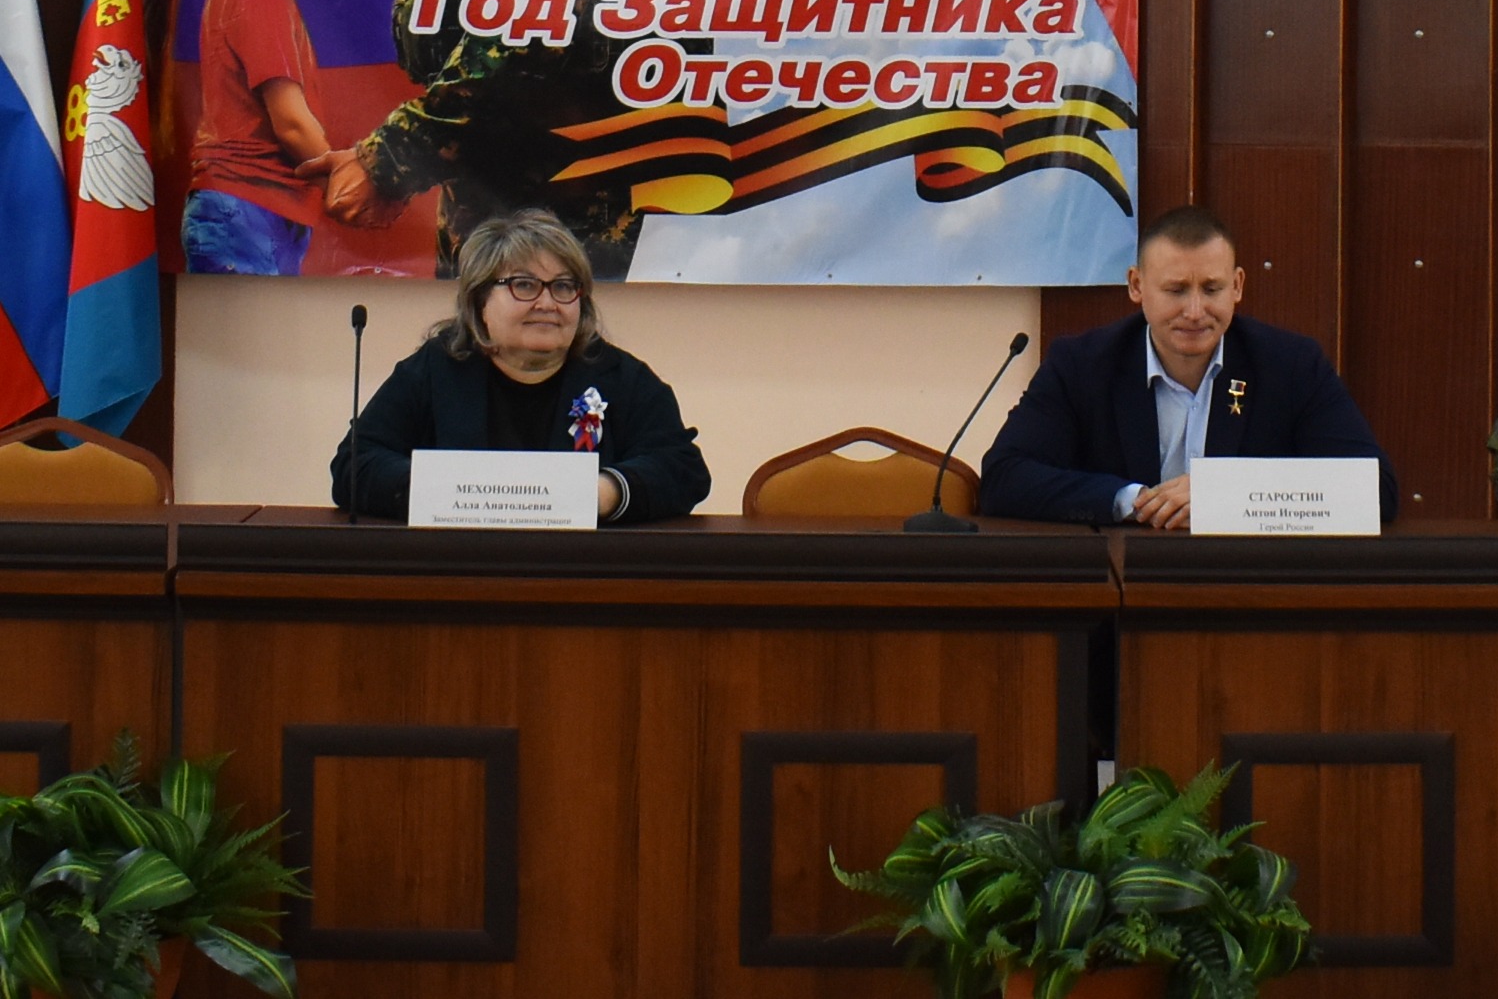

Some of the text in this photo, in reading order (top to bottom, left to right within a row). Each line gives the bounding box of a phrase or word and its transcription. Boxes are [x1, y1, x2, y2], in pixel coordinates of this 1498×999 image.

[615, 41, 1062, 109] Отечества
[456, 484, 550, 496] МЕХОНОШИНА
[1248, 492, 1324, 502] СТАРОСТИН
[452, 501, 552, 511] Алла Анатольевна
[1243, 508, 1330, 520] Антон Игоревич
[1259, 522, 1314, 532] Герой России
